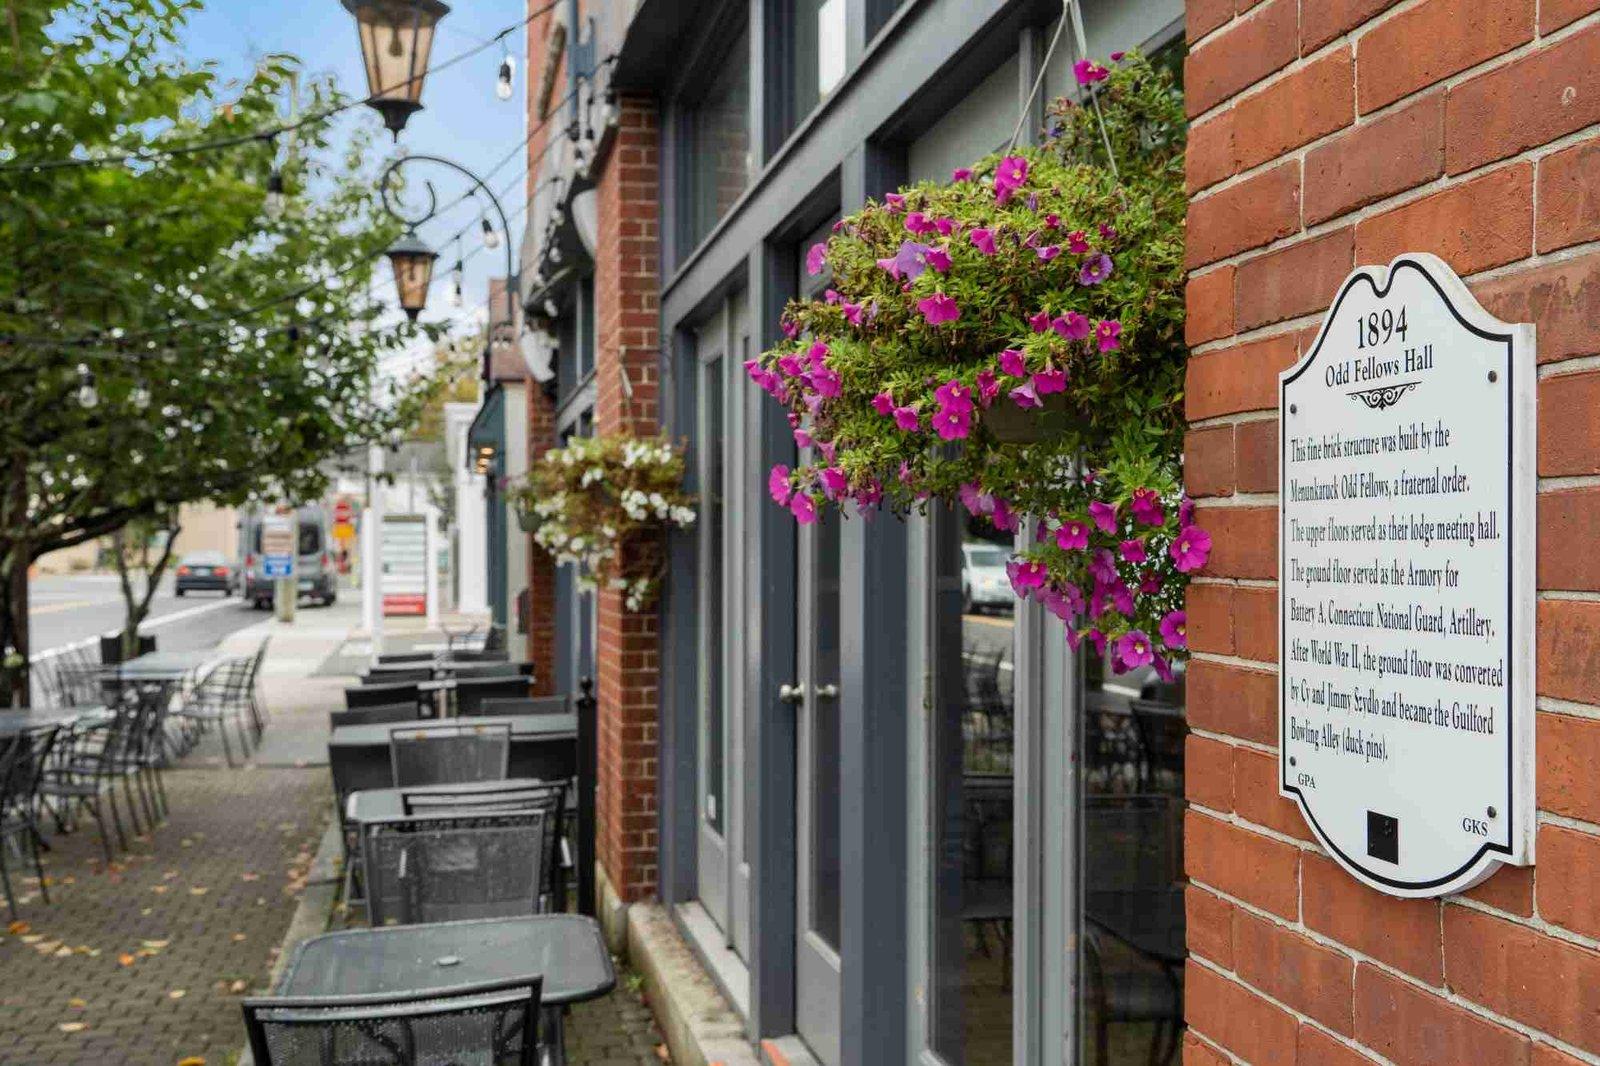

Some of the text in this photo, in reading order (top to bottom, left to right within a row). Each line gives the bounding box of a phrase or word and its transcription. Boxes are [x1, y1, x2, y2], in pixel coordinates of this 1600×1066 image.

[1357, 305, 1408, 349] 1894
[1326, 345, 1433, 387] Odd Fellows Hall
[1291, 420, 1450, 462] This fine brick structure was built by the
[1290, 465, 1470, 502] Menunkaruck Odd Fellows, a fraternal order.
[1291, 511, 1500, 547] The upper floors served as their lodge meeting hall.
[1291, 558, 1459, 594] The ground floor served as the Armory for
[1291, 598, 1495, 643] Battery A, Connecticut National Guard, Artillery.
[1291, 638, 1503, 687] After World War II, the ground floor was converted
[1291, 678, 1299, 704] by
[1301, 678, 1310, 708] Cy
[1312, 681, 1324, 705] and
[1327, 682, 1351, 712] Jimmy
[1382, 692, 1397, 717] and
[1399, 693, 1432, 724] became
[1434, 699, 1449, 727] the
[1452, 701, 1494, 734] Guilford
[1291, 716, 1388, 762] Bowling Alley (duck pins).
[1298, 773, 1316, 788] GPA
[1462, 817, 1489, 837] GKS
